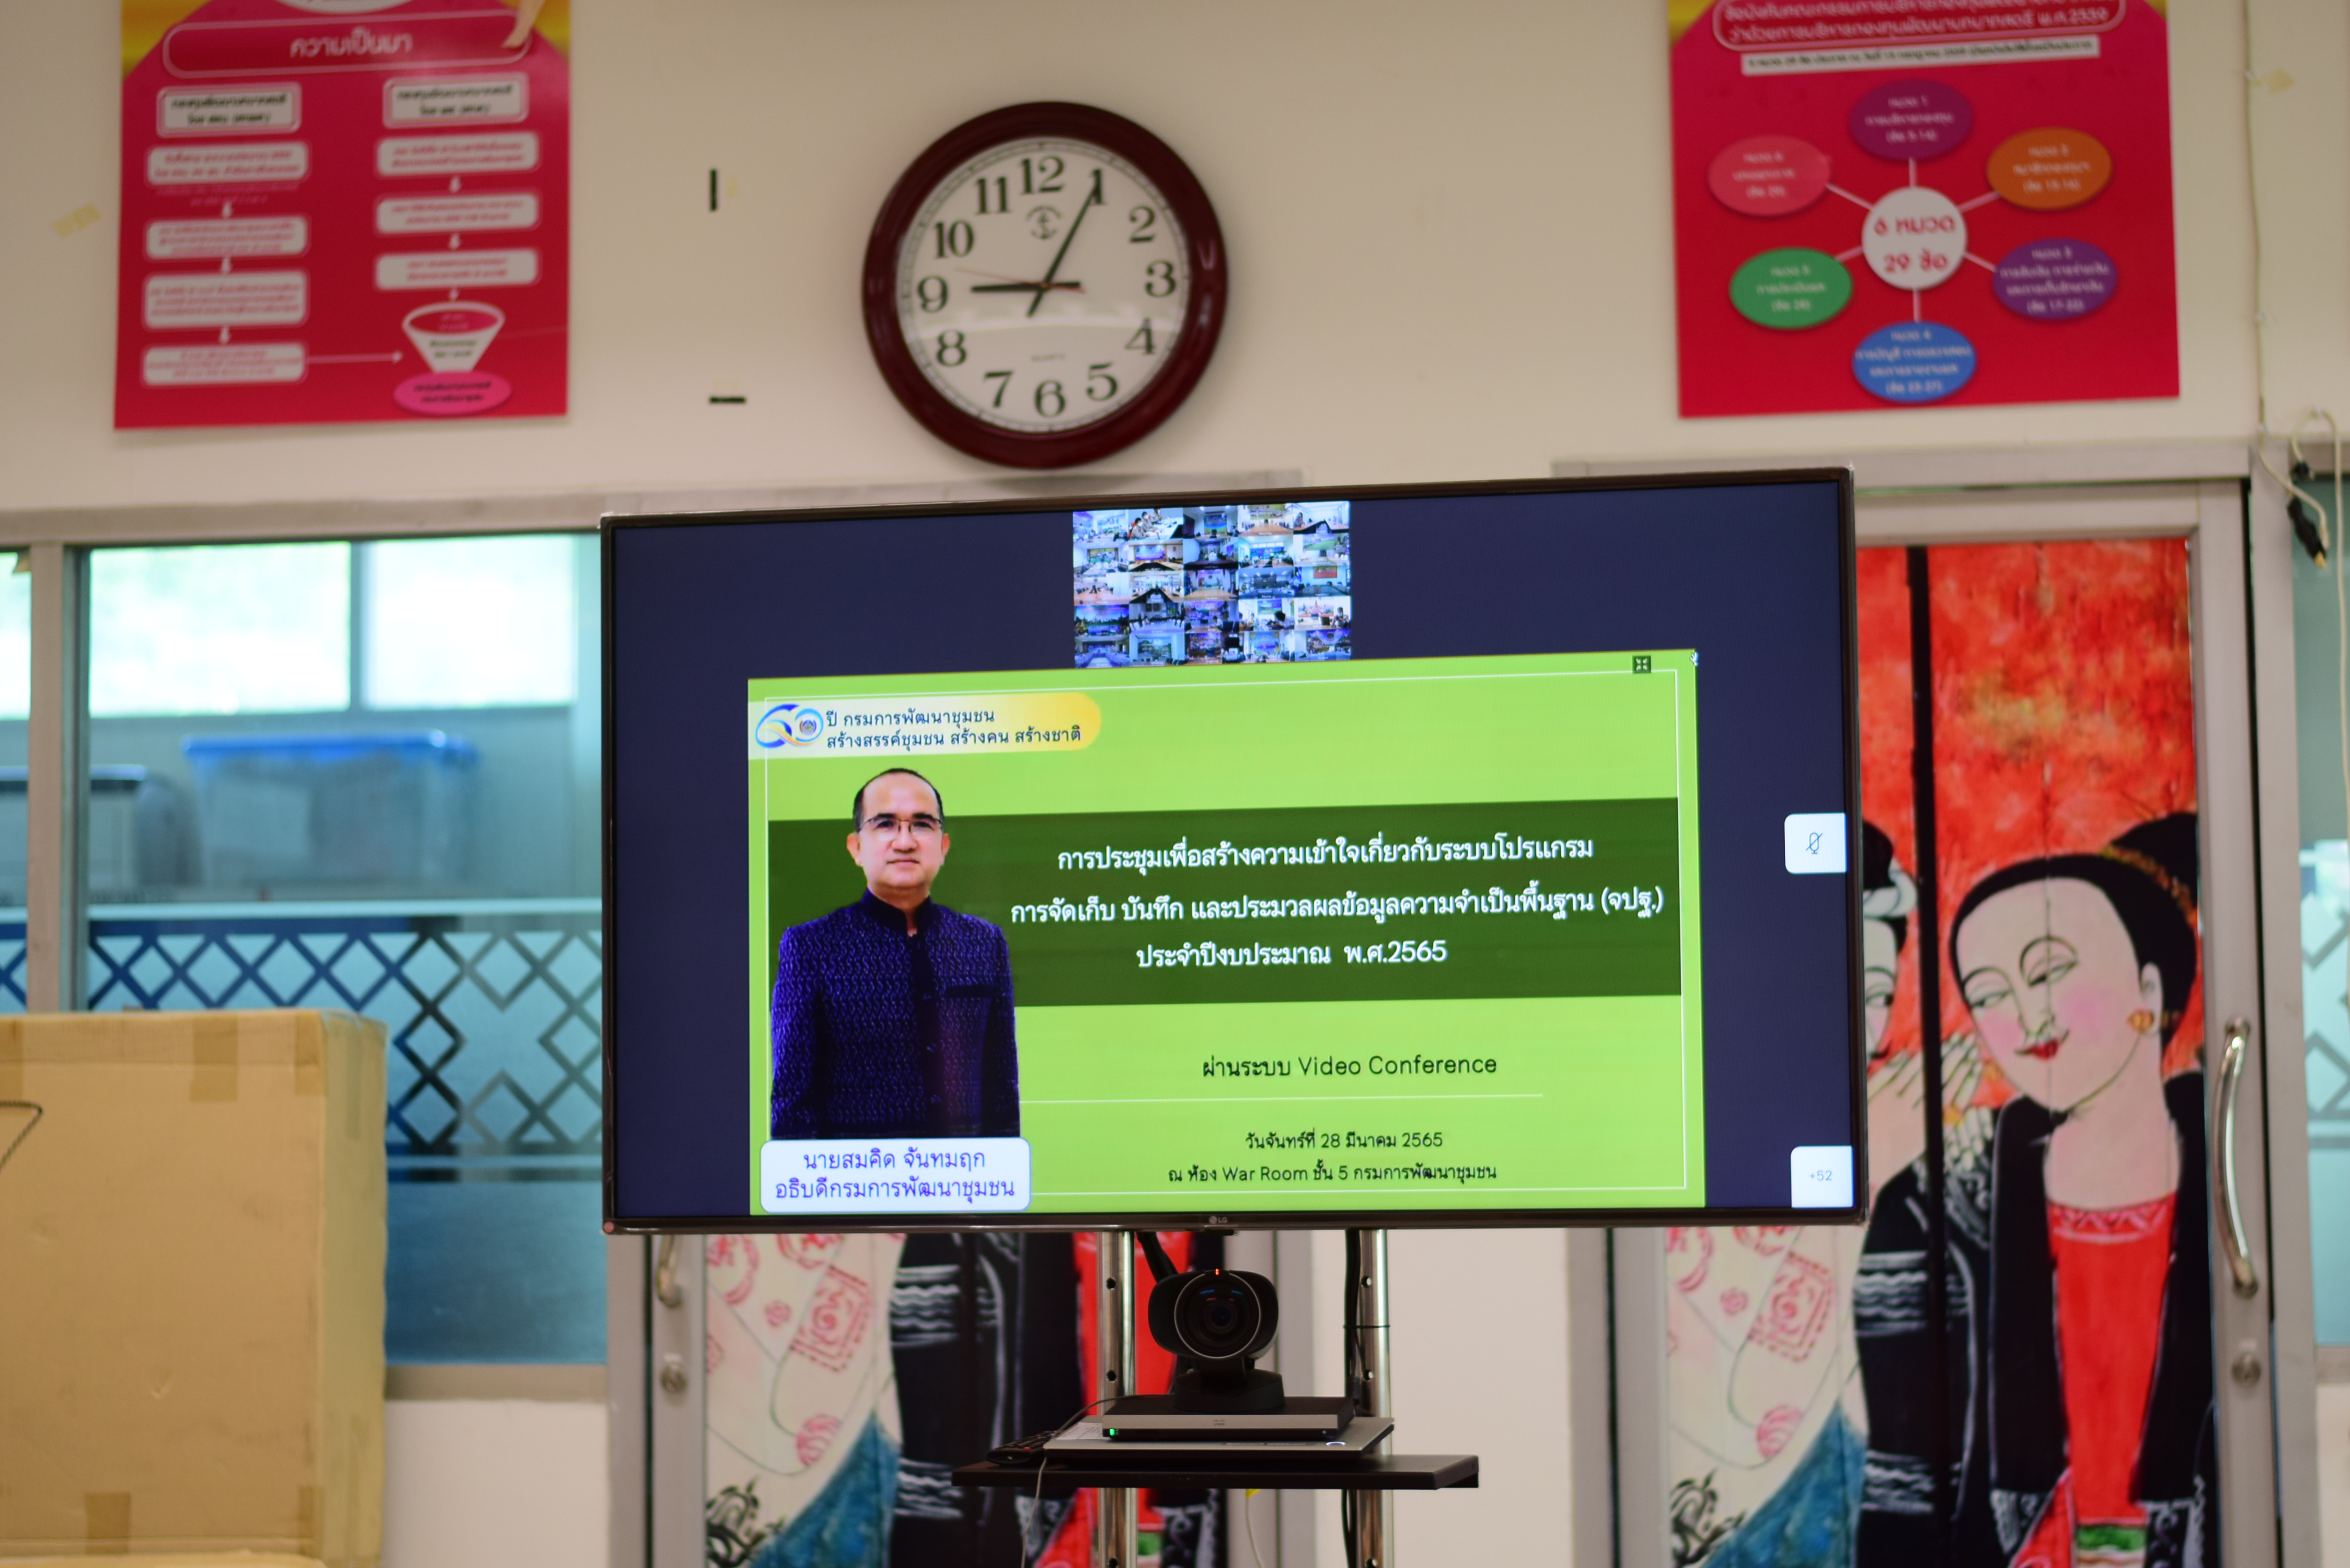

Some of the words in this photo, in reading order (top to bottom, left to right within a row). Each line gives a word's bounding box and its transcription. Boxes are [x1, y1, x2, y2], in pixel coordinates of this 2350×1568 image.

[290, 26, 413, 57] ความเป็นมา
[1019, 155, 1065, 194] 12
[1090, 168, 1107, 206] 1
[976, 176, 1011, 215] 11
[932, 220, 975, 259] 10
[1128, 205, 1156, 244] 2
[1874, 216, 1888, 236] 6
[1895, 215, 1956, 235] หมวด
[1145, 260, 1178, 297] 3
[1883, 252, 1911, 274] 29
[1919, 246, 1949, 272] ข้อ
[917, 275, 948, 313] 9
[936, 329, 967, 367] 8
[1124, 317, 1157, 356] 4
[984, 370, 1013, 409] 7
[1033, 380, 1066, 418] 6
[1086, 362, 1119, 401] 5
[826, 710, 837, 727] ปี
[844, 708, 995, 730] กรมการพัฒนาชุมชน
[827, 729, 944, 752] สร้างสรรค์ชุมชน
[950, 726, 1009, 745] สร้างคน
[1015, 724, 1081, 743] สร้างชาติ
[1058, 831, 1593, 876] การประชุมเพื่อสร้างความเข้าใจเกี่ยวกับระบบโปรแกรม
[1011, 895, 1115, 923] การจัดเก็บ
[1121, 895, 1184, 920] บันทึก
[1191, 880, 1594, 924] และประมวลผลข้อมูลความจำเป็นพื้นฐาน
[1600, 885, 1664, 919] (จปฐ.)
[1136, 940, 1332, 968] ประจำปีงบประมาณ
[1343, 939, 1448, 964] พ.ศ.2565
[1203, 1055, 1291, 1077] ผ่านระบบ
[1297, 1056, 1362, 1076] Video
[1368, 1054, 1497, 1075] Conference
[1245, 1127, 1316, 1149] วันจันทร์ที่
[1320, 1133, 1341, 1148] 28
[1345, 1131, 1397, 1148] มีนาคม
[1401, 1132, 1443, 1148] 2565
[803, 1147, 896, 1169] นายสมคิด
[903, 1146, 986, 1172] จันทมฤก
[1168, 1169, 1183, 1182] ณ
[1187, 1164, 1217, 1182] ห้อง
[1222, 1167, 1256, 1182] War
[1260, 1166, 1308, 1181] Room
[1312, 1158, 1334, 1180] ชั้น
[1338, 1165, 1349, 1180] 5
[1353, 1162, 1497, 1184] กรมการพัฒนาชุมชน
[1810, 1169, 1833, 1182] +52
[776, 1175, 1015, 1204] อธิบดีกรมการพัฒนาชุมชน
